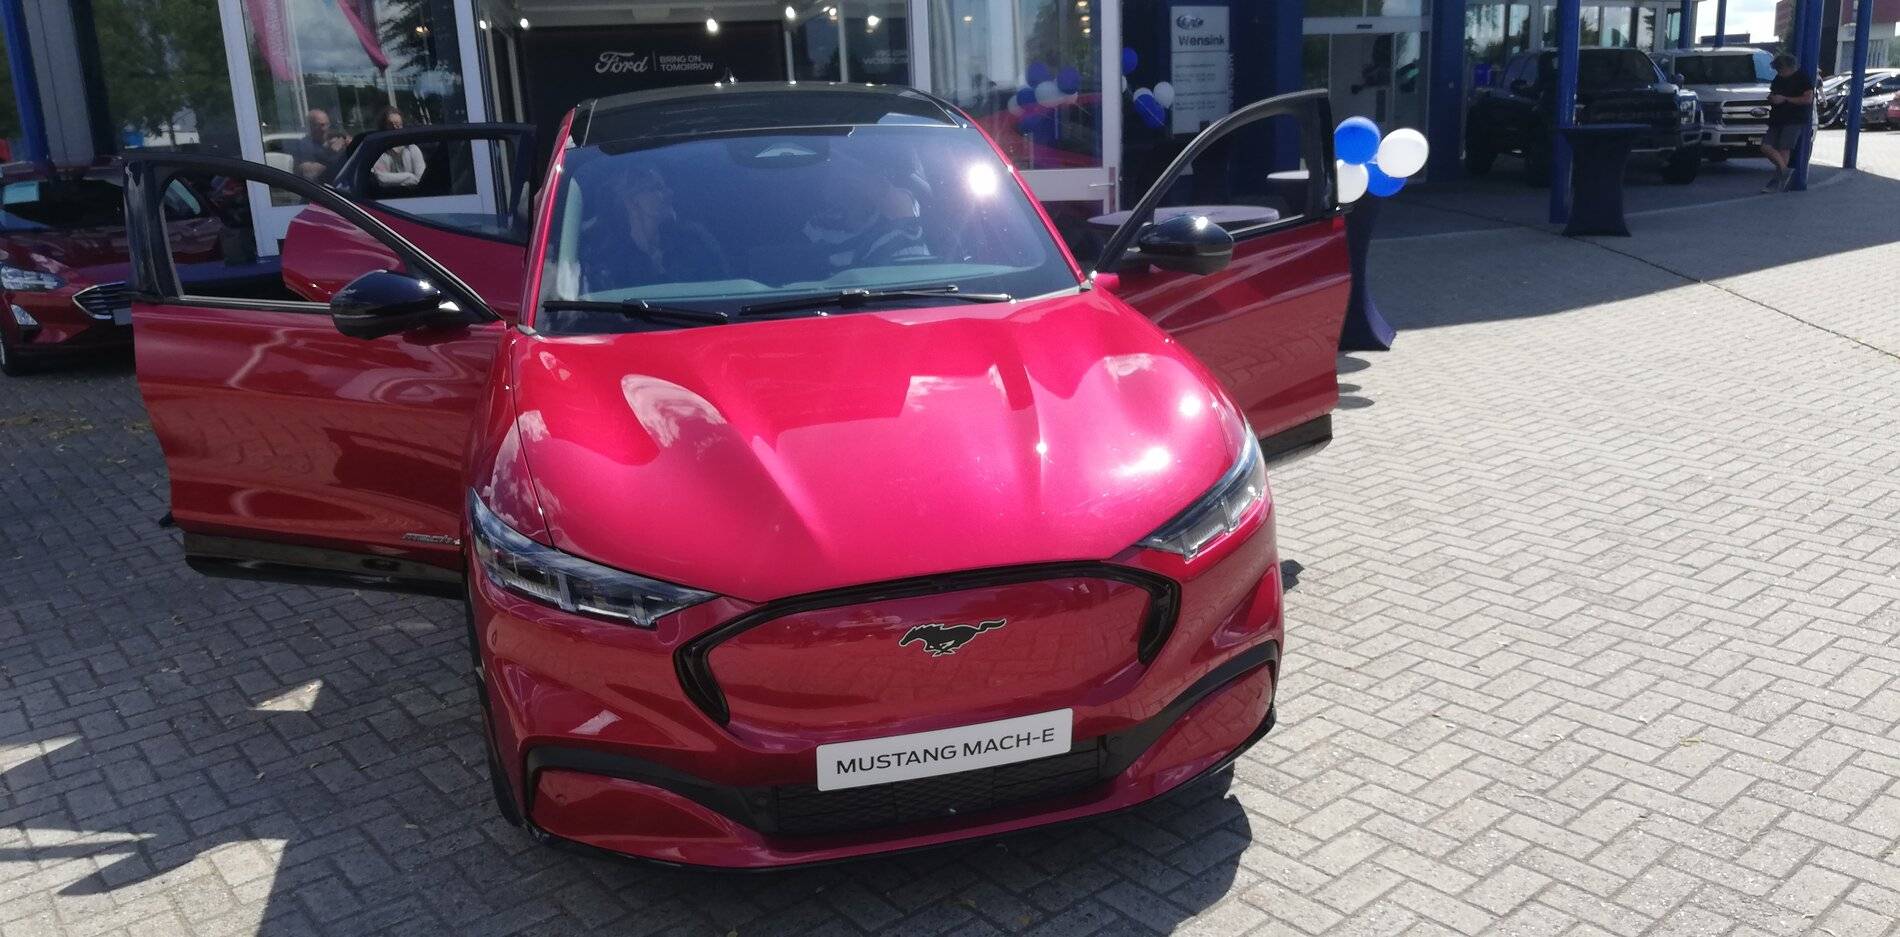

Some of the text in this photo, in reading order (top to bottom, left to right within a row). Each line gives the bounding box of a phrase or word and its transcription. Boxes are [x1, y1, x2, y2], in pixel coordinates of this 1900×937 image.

[1178, 34, 1225, 46] Wensink
[594, 51, 649, 74] Ford
[659, 54, 702, 63] BRING ON
[660, 62, 714, 72] TOMORROW
[836, 727, 1055, 775] MUSTANG MACH-E
